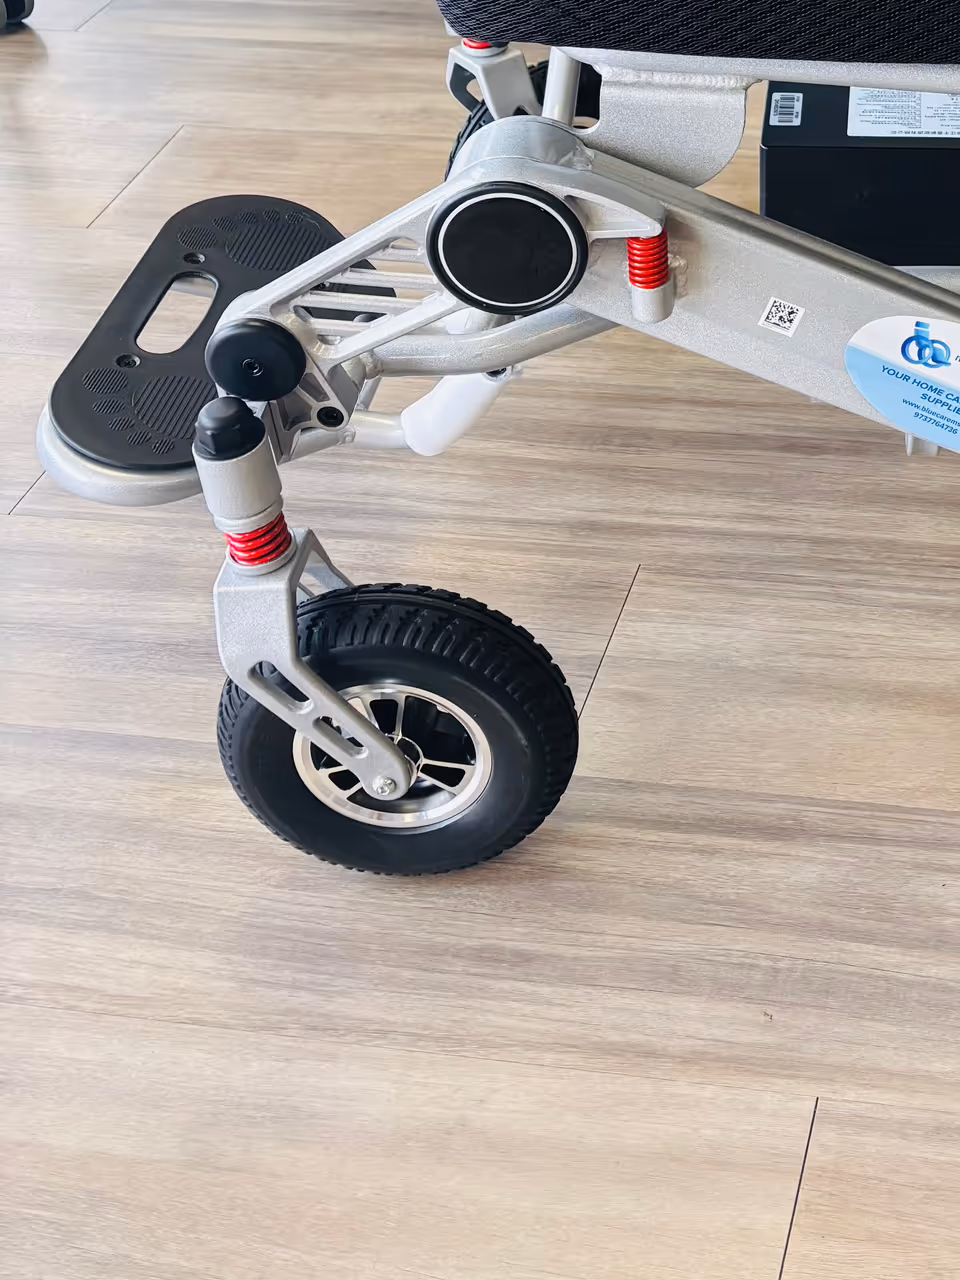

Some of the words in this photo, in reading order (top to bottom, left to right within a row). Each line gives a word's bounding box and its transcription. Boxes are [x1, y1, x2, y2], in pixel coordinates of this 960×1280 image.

[881, 365, 911, 382] YOUR
[912, 378, 945, 396] HOME
[913, 411, 959, 435] 9737764736
